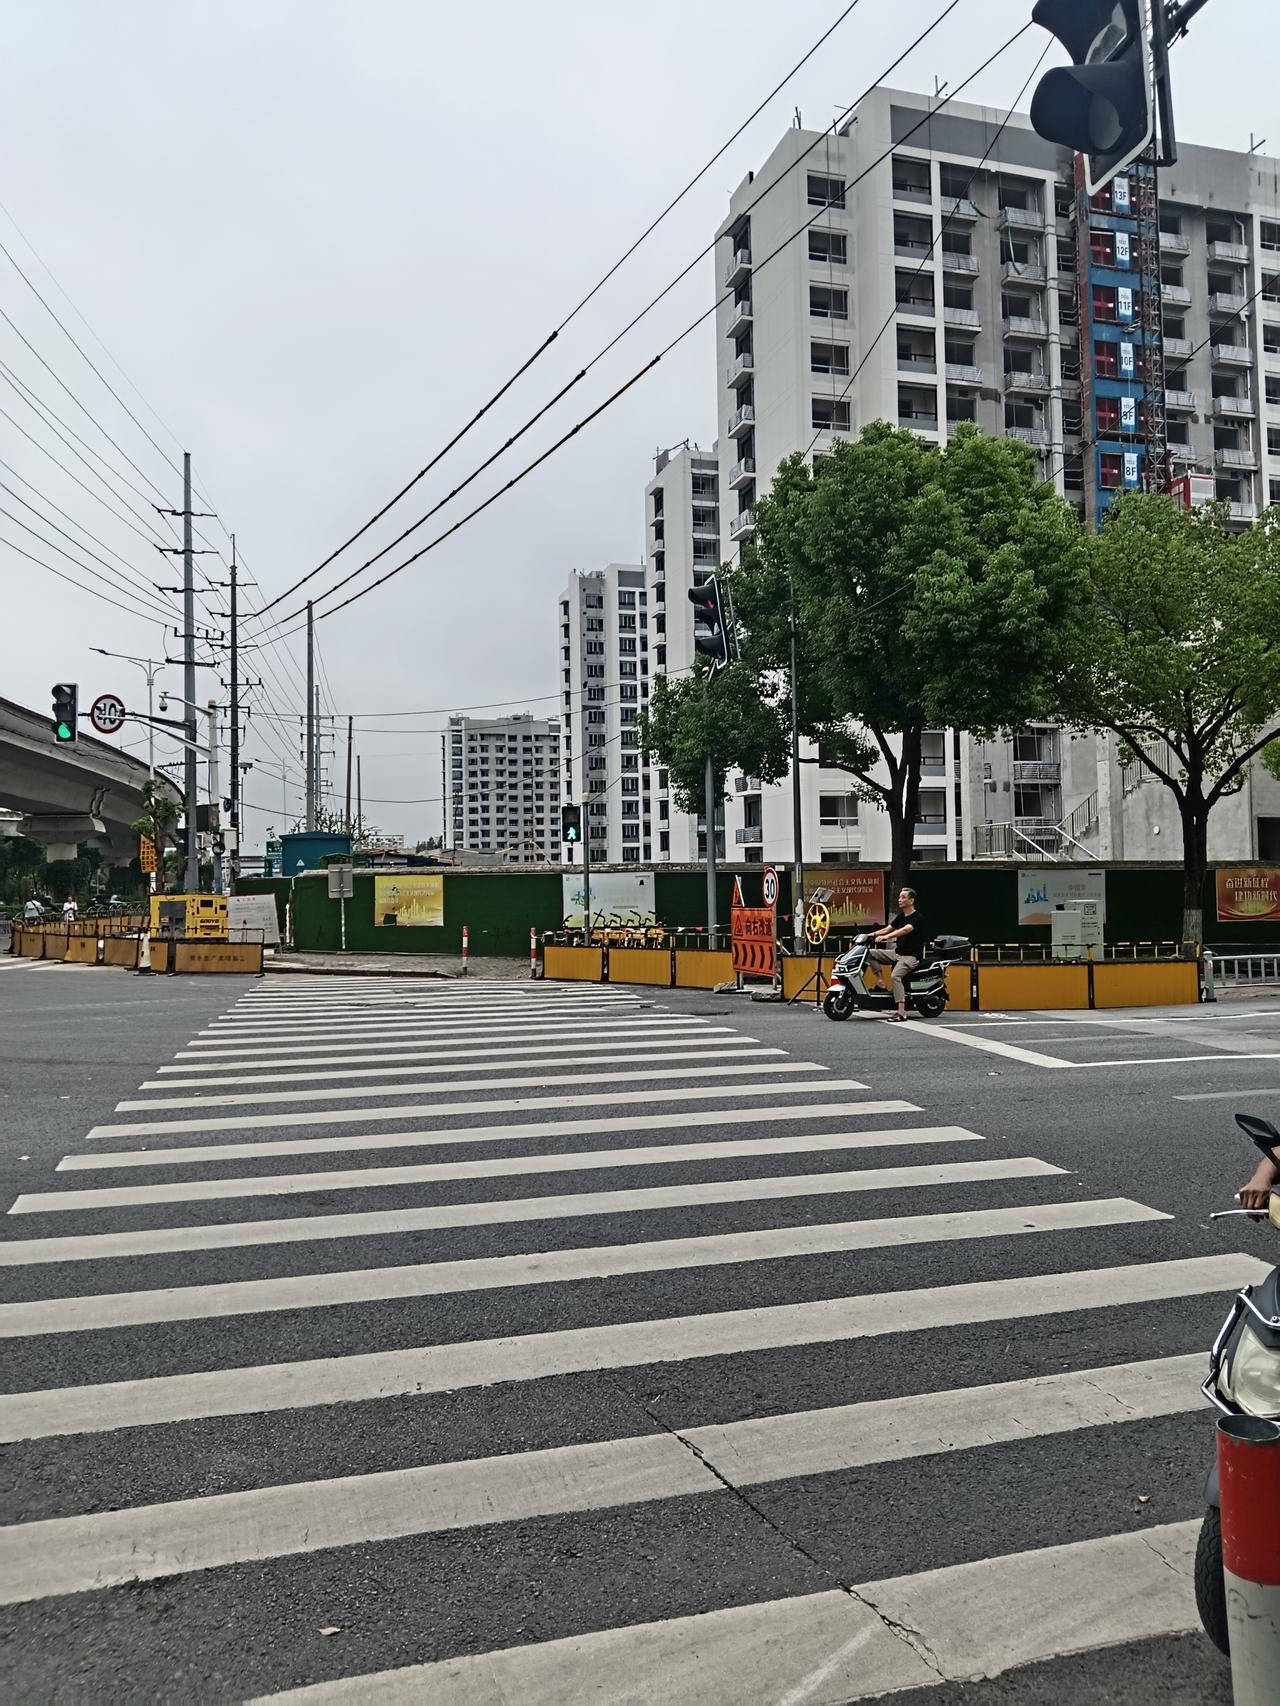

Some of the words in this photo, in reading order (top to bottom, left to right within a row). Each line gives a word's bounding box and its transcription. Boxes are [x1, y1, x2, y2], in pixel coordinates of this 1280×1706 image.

[1114, 190, 1127, 201] 13F
[1116, 245, 1129, 257] 12F
[1118, 301, 1132, 311] 11F
[1120, 356, 1133, 366] 10F
[1122, 409, 1134, 421] 9F
[1125, 466, 1137, 477] 8F
[765, 878, 774, 899] 30
[745, 917, 772, 936] 向右改道
